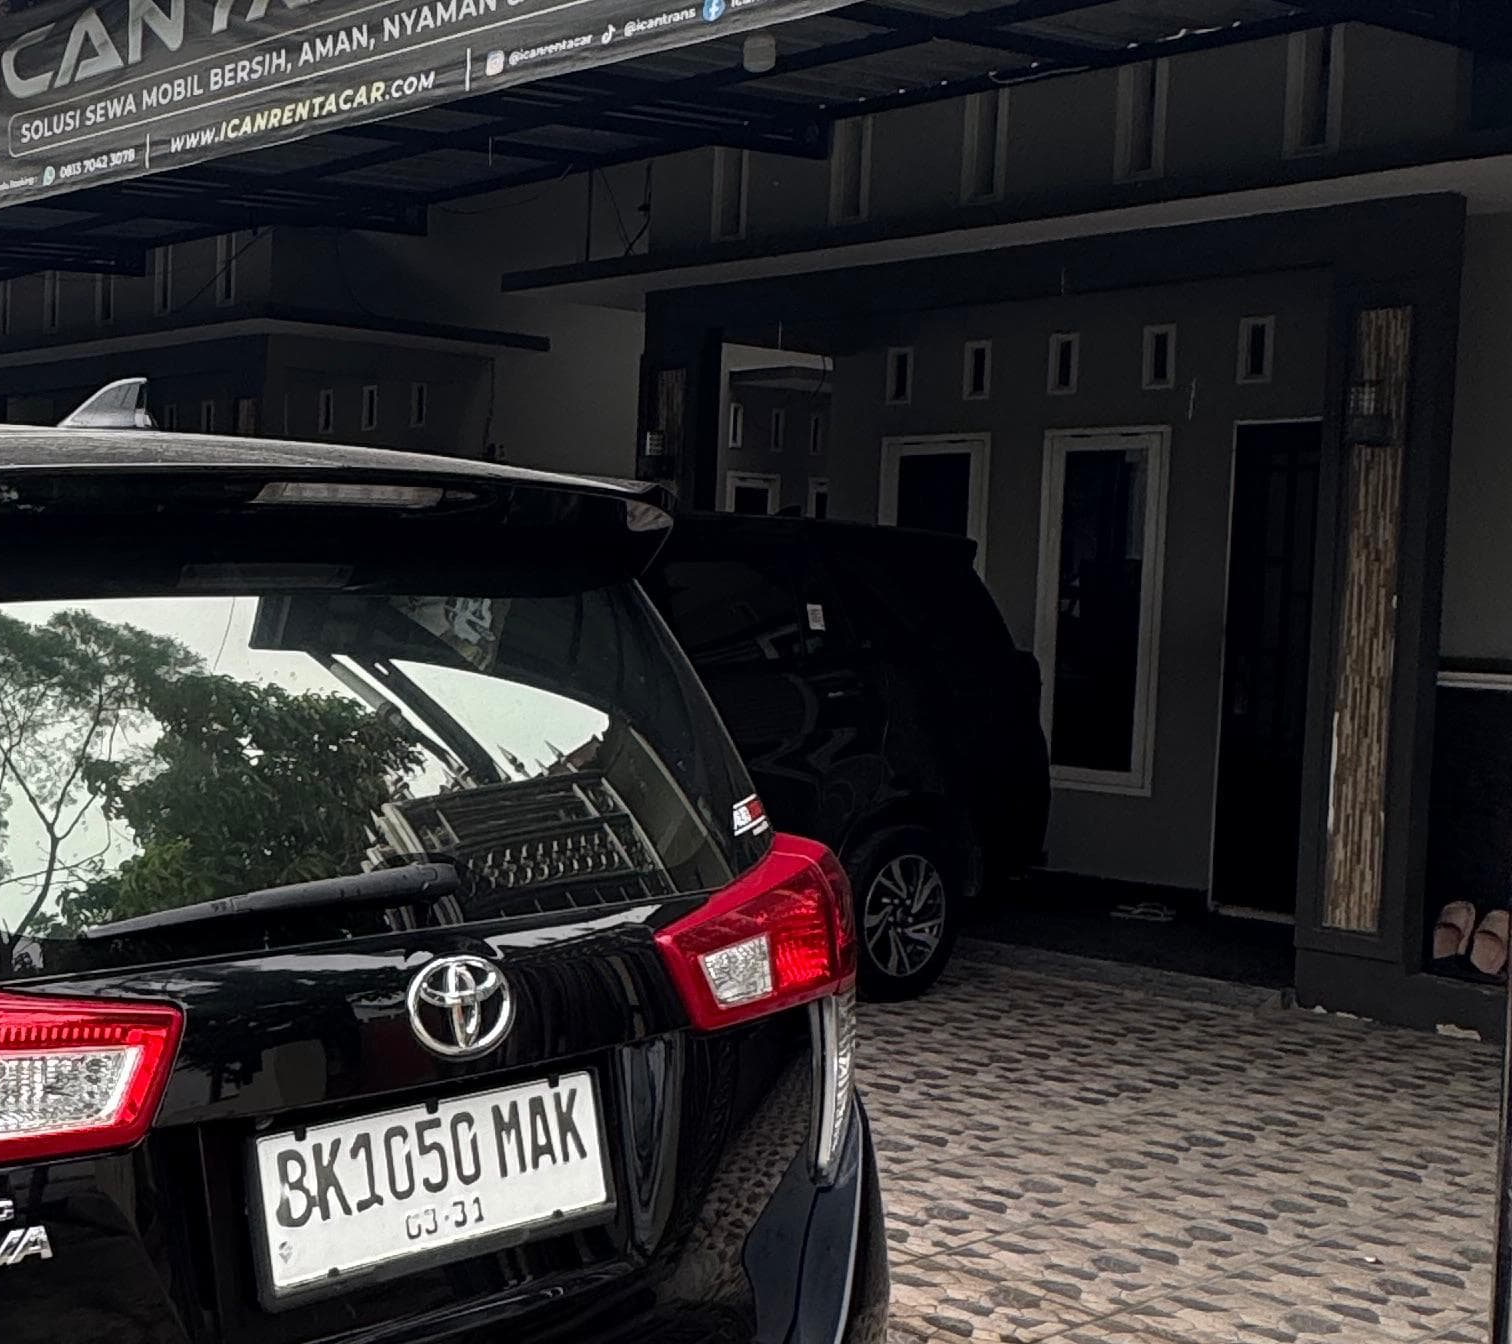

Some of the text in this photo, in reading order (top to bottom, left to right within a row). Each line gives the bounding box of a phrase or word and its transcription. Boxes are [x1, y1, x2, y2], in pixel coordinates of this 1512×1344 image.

[623, 6, 697, 39] @icantrans
[20, 108, 81, 144] SOLUSI
[85, 92, 137, 126] SEWA
[141, 70, 204, 111] MOBIL
[209, 47, 292, 92] BERSIH,
[297, 22, 376, 68] AMAN,
[169, 70, 436, 154] WWW.ICANRENTACAR.COM
[490, 1087, 588, 1179] MAK
